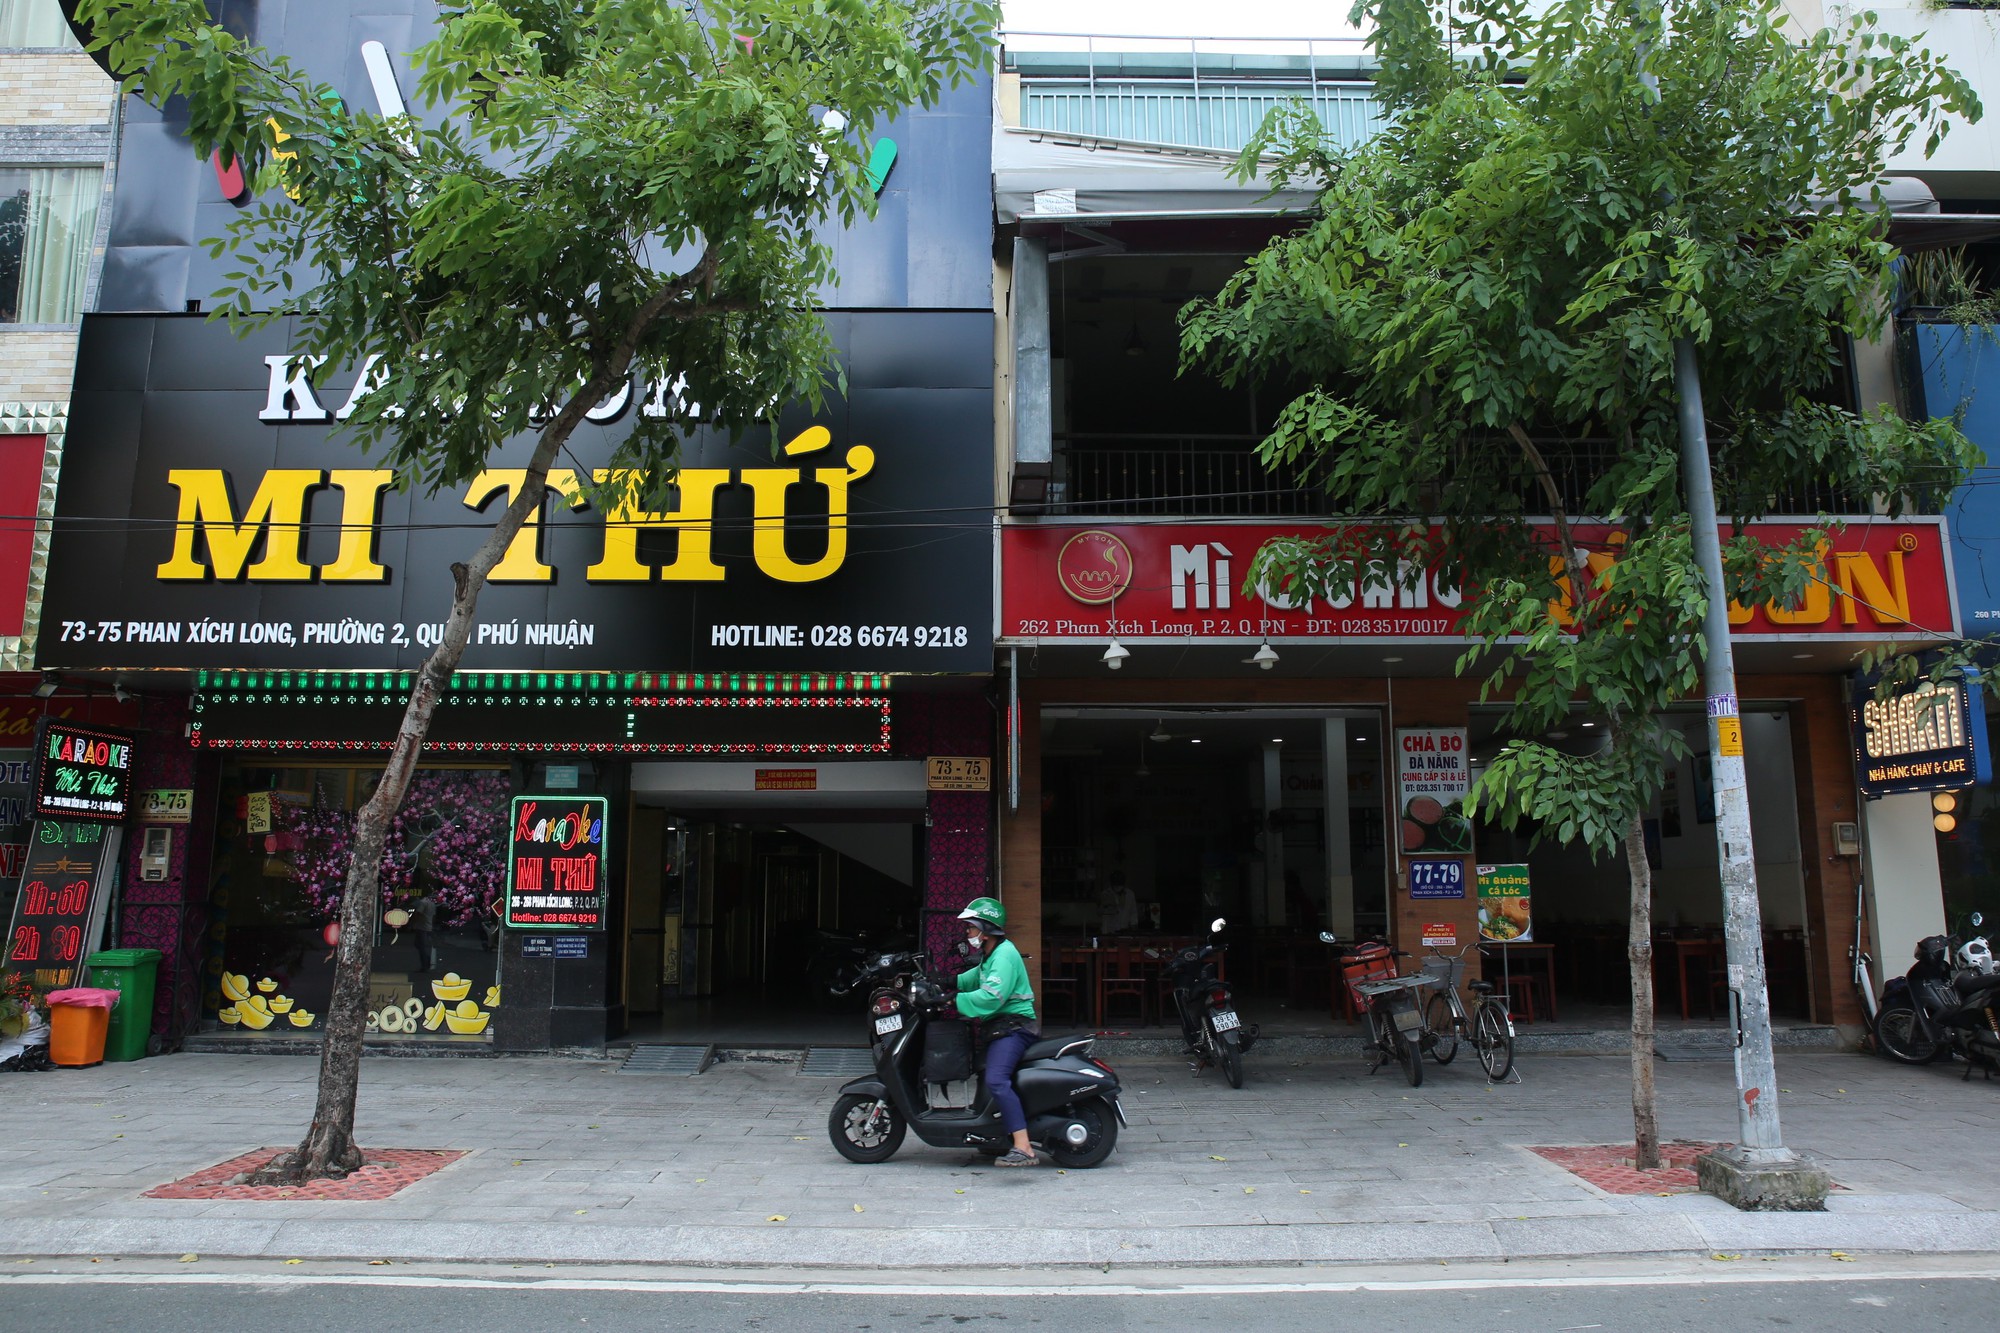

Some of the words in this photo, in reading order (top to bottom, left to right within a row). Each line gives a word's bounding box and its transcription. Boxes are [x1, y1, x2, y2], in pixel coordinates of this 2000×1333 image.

[157, 469, 395, 581] MI
[462, 425, 876, 583] THỨ
[1974, 610, 1989, 619] 260
[126, 622, 180, 643] PHAN
[186, 617, 234, 644] XÍCH
[239, 622, 298, 648] LONG,
[303, 617, 384, 645] PHƯỜNG
[391, 623, 410, 648] 2,
[416, 620, 472, 648] QU
[478, 619, 519, 645] PHÚ
[525, 619, 595, 649] NHUẬN
[711, 625, 804, 647] HOTLINE:
[810, 625, 852, 647] 028
[857, 625, 909, 647] 6674
[914, 626, 968, 647] 9218
[1019, 620, 1049, 634] 262
[1055, 620, 1100, 634] Phan
[1106, 620, 1144, 634] Xích
[1150, 620, 1198, 637] Long,
[1202, 620, 1216, 634] P.
[1220, 620, 1236, 636] 2,
[1306, 620, 1337, 634] ĐT:
[1403, 731, 1436, 752] CHẢ
[1440, 731, 1462, 752] BÒ
[1731, 731, 1738, 743] 2
[936, 760, 952, 775] 73
[965, 760, 981, 775] 75
[1409, 754, 1424, 769] ĐÀ
[1427, 752, 1458, 769] NẴNG
[1402, 772, 1422, 782] CUNG
[1424, 770, 1438, 782] CẤP
[1450, 772, 1456, 781] &
[1868, 766, 1886, 782] NHÀ
[1887, 764, 1910, 779] HÀNG
[1911, 762, 1933, 777] CHAY
[1934, 761, 1942, 774] &
[1943, 758, 1967, 773] CAFE
[55, 766, 83, 793] Mi
[1405, 784, 1415, 792] ĐT:
[1443, 784, 1455, 792] 700
[1456, 784, 1464, 792] 17
[516, 857, 543, 891] MI
[551, 853, 597, 891] THỨ
[1493, 875, 1529, 886] Quảng
[1488, 885, 1500, 895] Cá
[1503, 885, 1520, 895] Lóc
[532, 895, 546, 908] PHAN
[547, 893, 559, 908] XÍCH
[512, 913, 541, 922] Hotline:
[543, 913, 557, 922] 028
[558, 913, 577, 923] 6674
[578, 914, 597, 923] 9218
[982, 908, 999, 919] Grab
